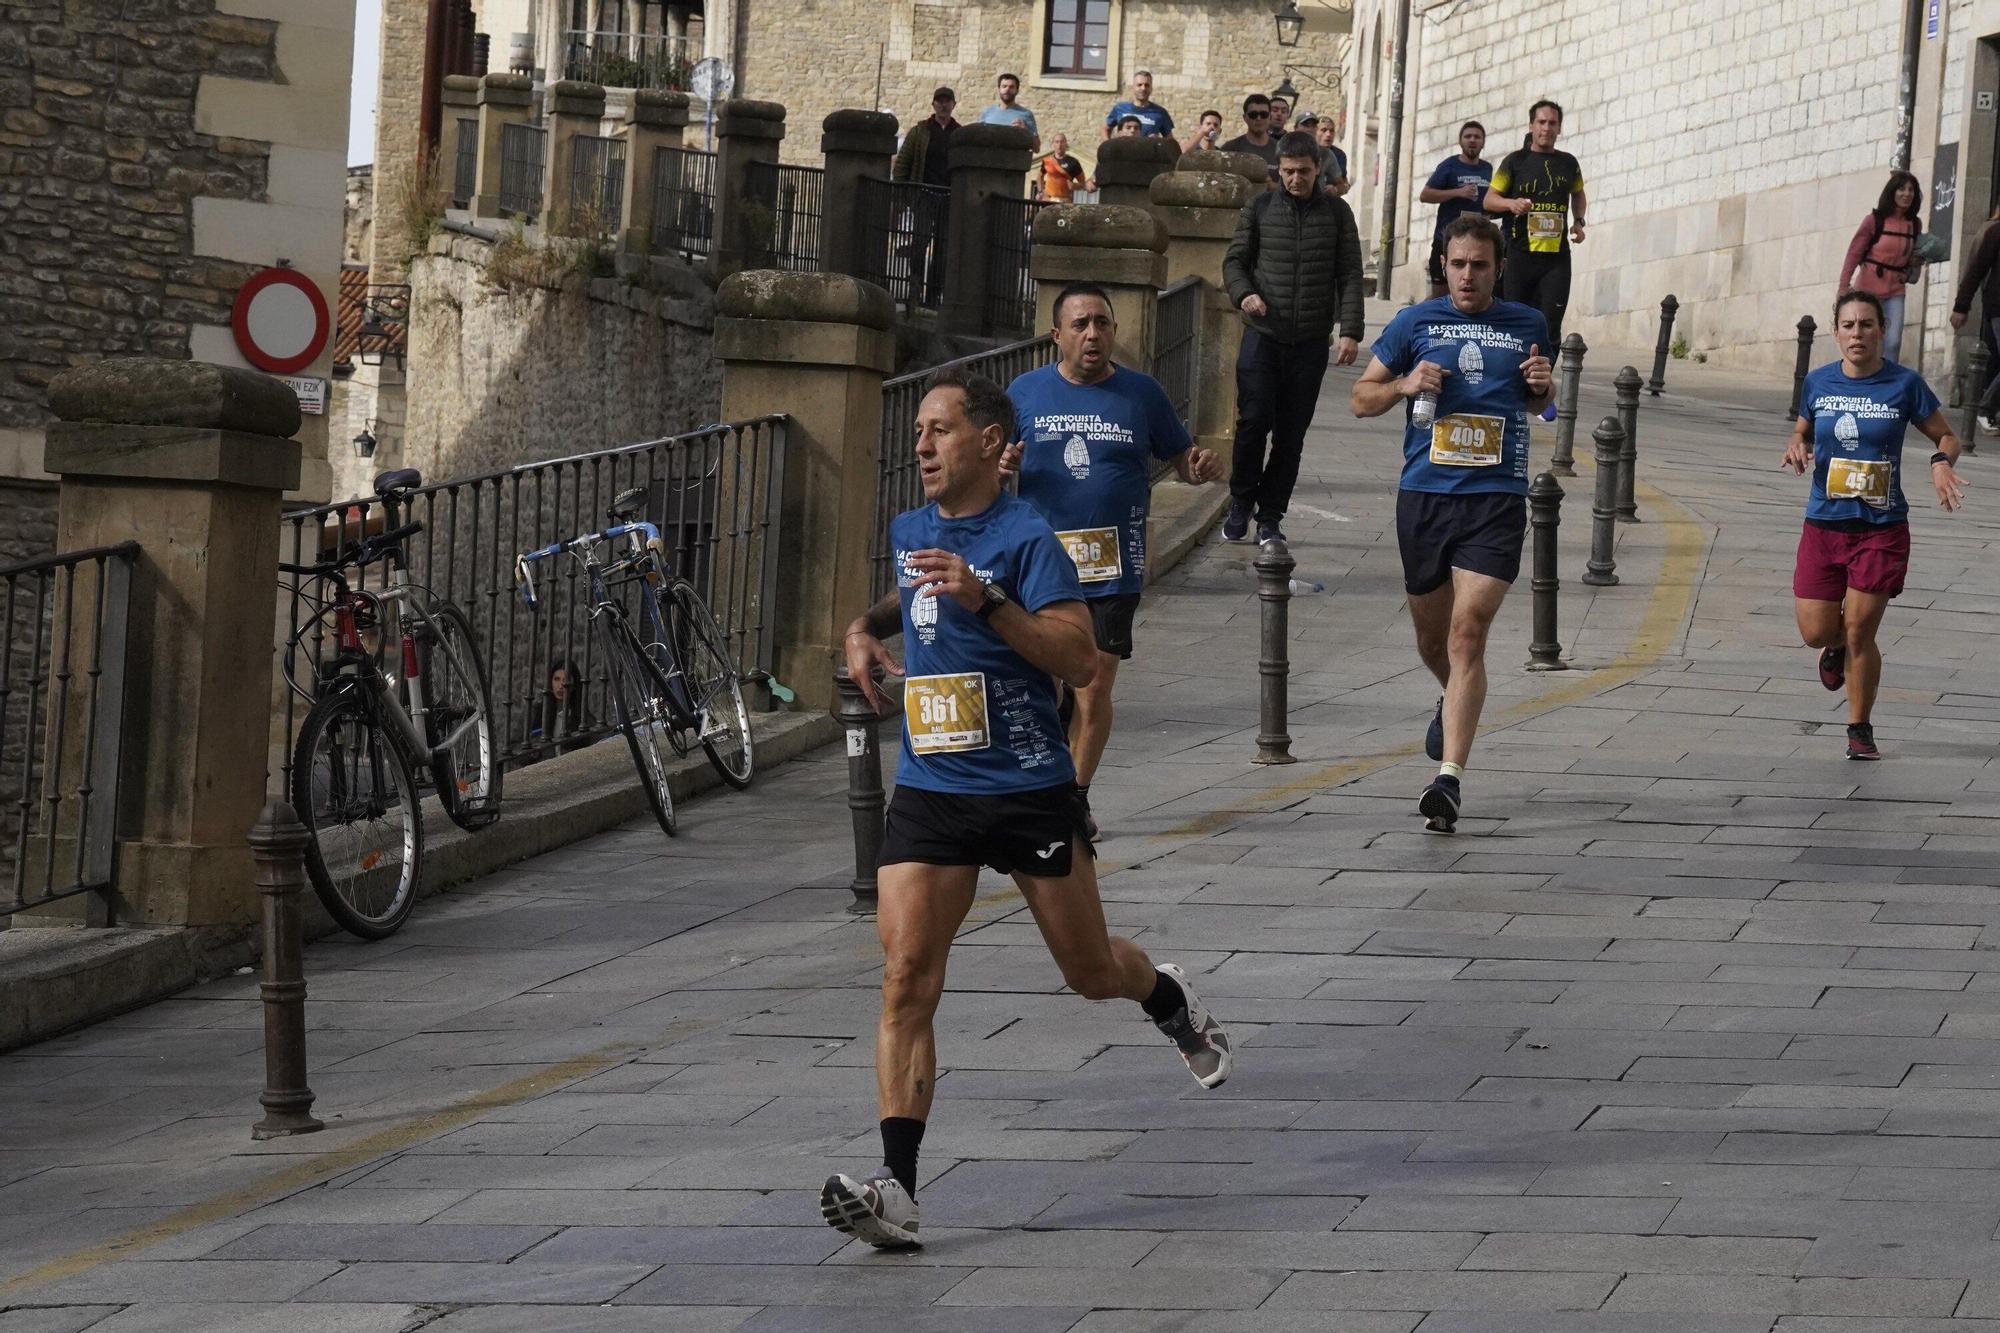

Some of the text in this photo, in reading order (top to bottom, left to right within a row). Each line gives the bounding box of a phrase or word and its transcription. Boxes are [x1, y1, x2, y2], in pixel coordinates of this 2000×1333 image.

[1440, 324, 1493, 332] CONQUISTA
[1443, 332, 1512, 341] ALMENDRA
[1482, 340, 1523, 352] KONKISTA
[1824, 396, 1872, 404] CONQUISTA
[1825, 403, 1888, 412] ALMENDRA
[1035, 415, 1101, 424] LA CONQUISTA
[1048, 422, 1120, 433] ALMENDRA
[1087, 433, 1133, 443] KONKISTA
[1450, 426, 1485, 448] 409
[1845, 472, 1874, 490] 451
[1068, 542, 1101, 562] 436
[964, 680, 978, 689] 10K
[920, 694, 958, 725] 361
